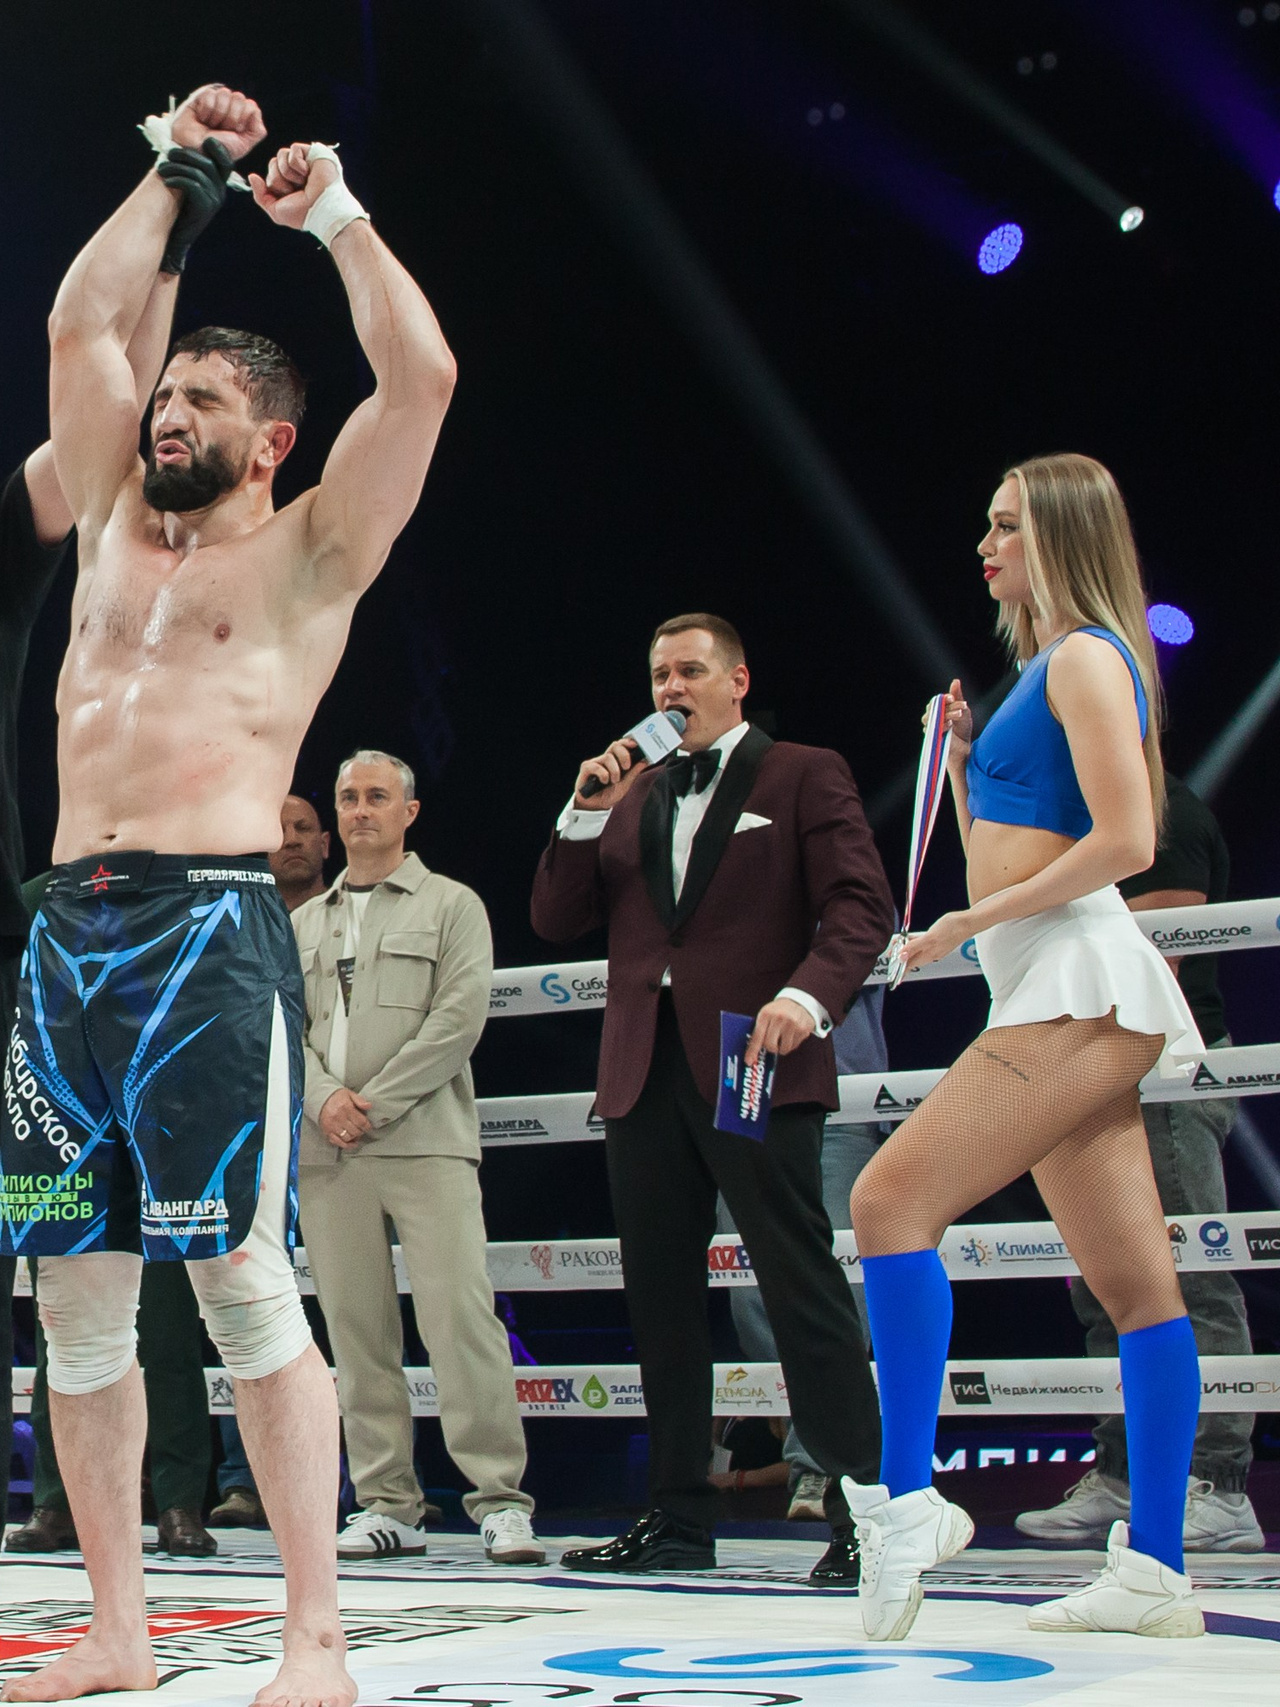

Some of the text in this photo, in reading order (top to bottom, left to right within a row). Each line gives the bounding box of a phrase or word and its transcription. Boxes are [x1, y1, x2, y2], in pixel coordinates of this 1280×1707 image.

[1152, 925, 1252, 943] Сибирское
[149, 1198, 229, 1218] АВАНГАРД
[173, 1224, 229, 1236] КОМПАНИЯ
[996, 1242, 1066, 1257] Климат
[1204, 1248, 1232, 1257] ОТС
[952, 1383, 1104, 1397] ГИС Недвижимость
